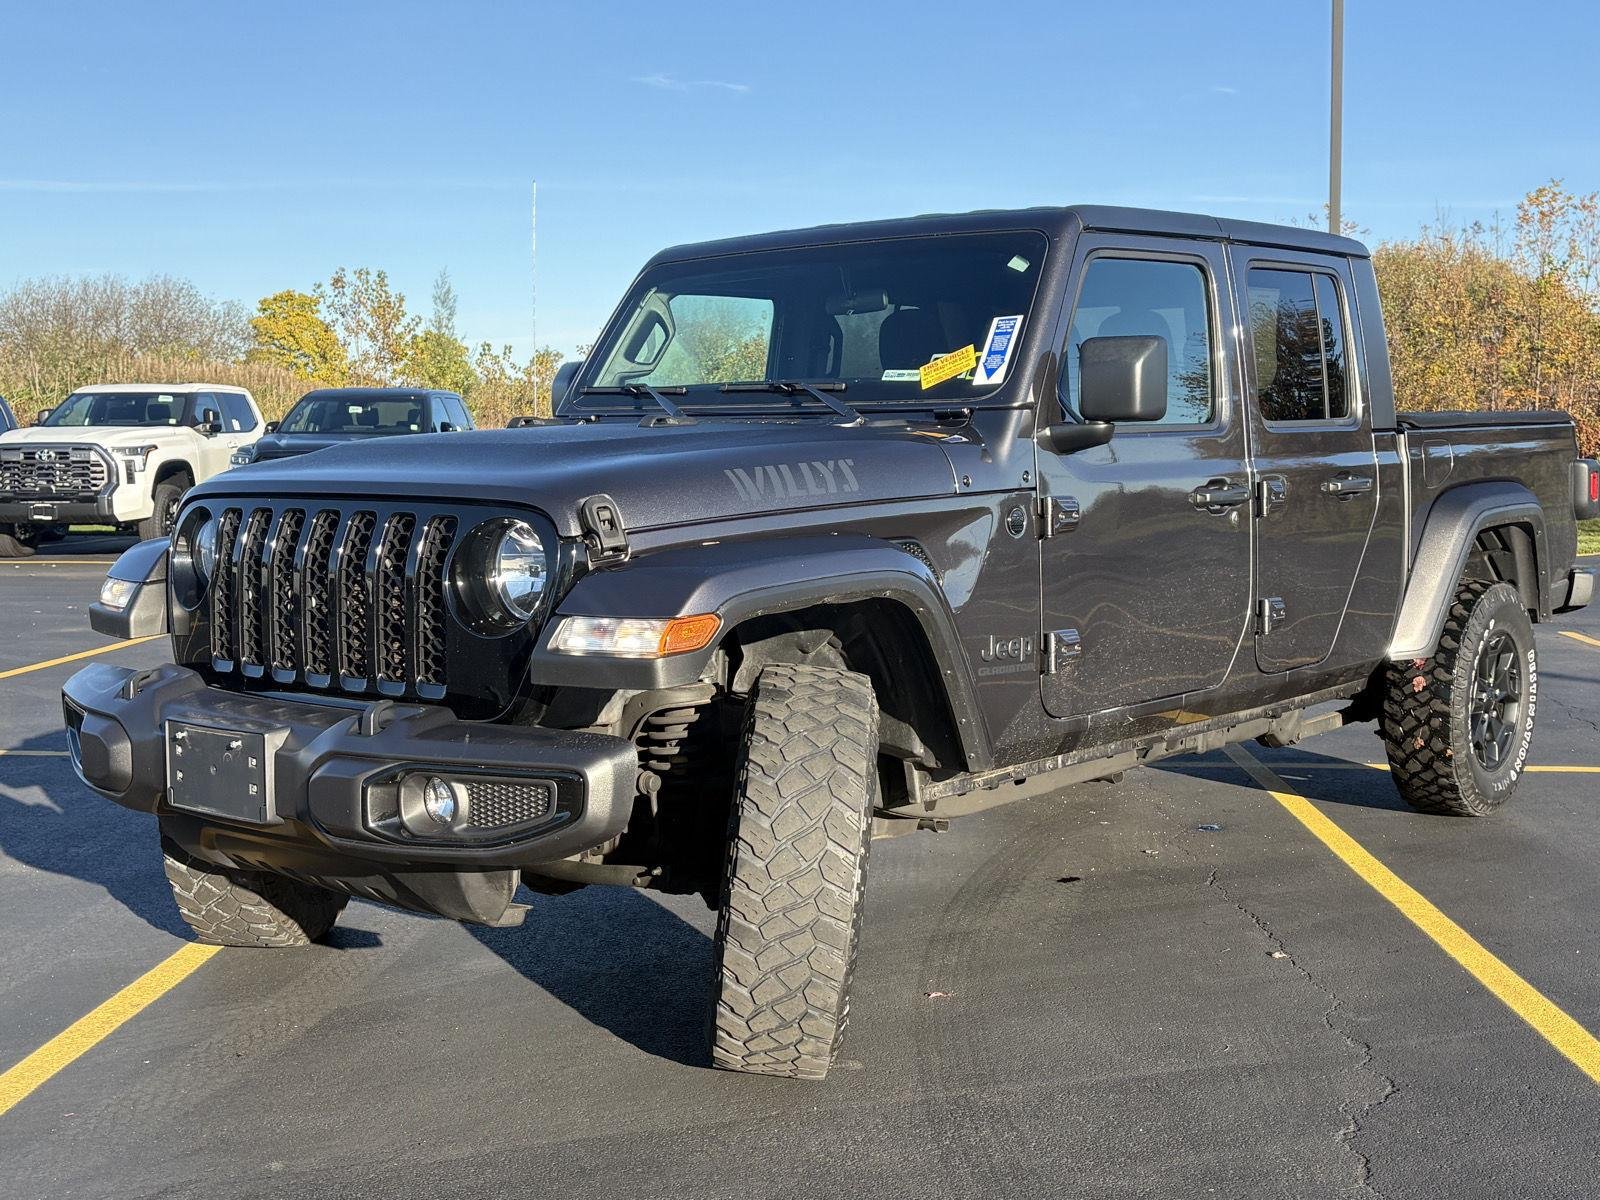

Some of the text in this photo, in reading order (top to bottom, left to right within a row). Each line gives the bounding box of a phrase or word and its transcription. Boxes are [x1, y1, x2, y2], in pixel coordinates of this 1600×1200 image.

[940, 349, 970, 364] VEHICLE
[723, 458, 860, 502] WILLYS
[981, 634, 1033, 663] Jeep
[978, 662, 1036, 677] GLADIATOR
[1513, 648, 1538, 772] DESTINATION
